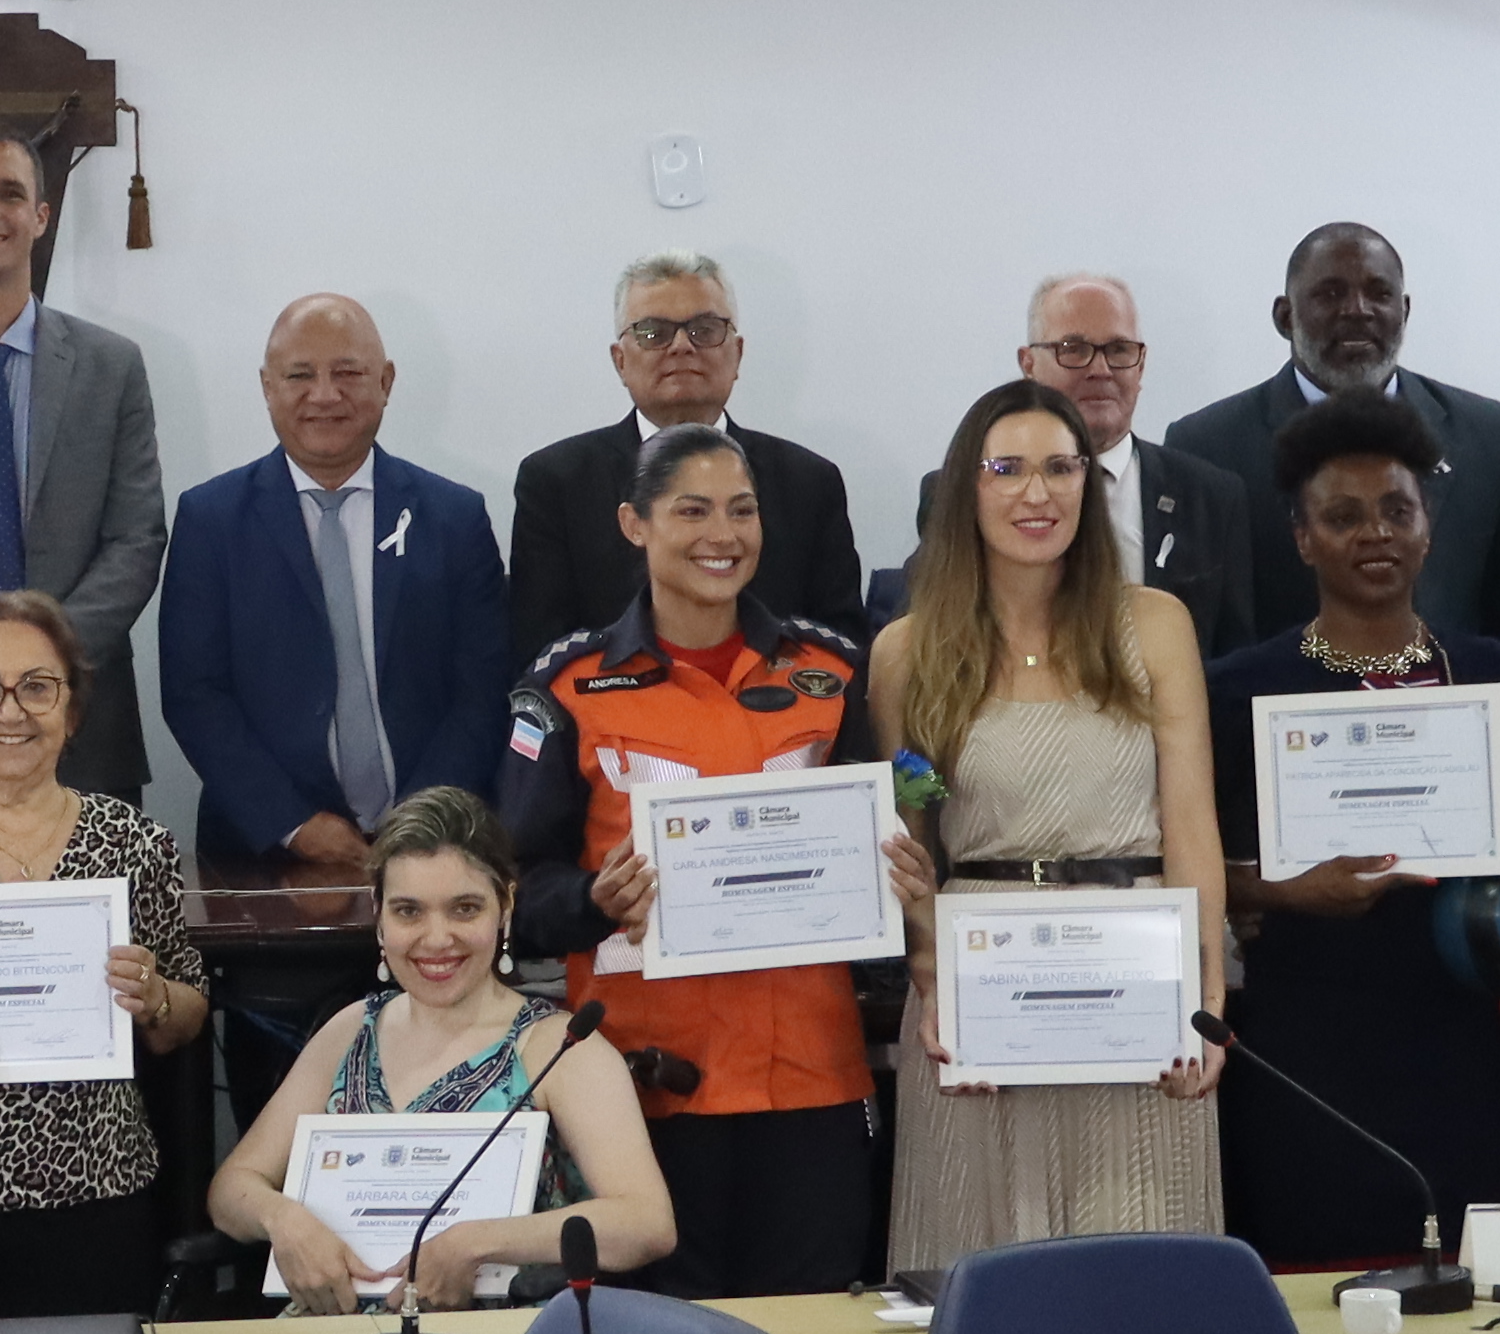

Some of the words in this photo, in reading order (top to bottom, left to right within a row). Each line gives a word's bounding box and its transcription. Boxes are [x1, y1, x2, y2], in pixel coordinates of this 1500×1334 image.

[588, 677, 639, 689] ANDRESA
[1376, 723, 1406, 732] Câmara
[1376, 729, 1415, 738] Municipal
[759, 805, 791, 815] Câmara
[759, 812, 801, 822] Municipal
[672, 859, 708, 871] CARLA
[709, 854, 760, 868] ANDRESA
[760, 849, 829, 863] NASCIMENTO
[830, 846, 860, 857] SILVA
[1061, 924, 1093, 932] Câmara
[1061, 931, 1102, 940] Municipal
[13, 963, 87, 977] BITTENCOURT
[979, 974, 1029, 986] SABINA
[1032, 972, 1105, 985] BANDEIRA
[412, 1146, 443, 1155] Câmara
[411, 1153, 451, 1162] Municipal
[345, 1189, 408, 1202] BÁRBARA
